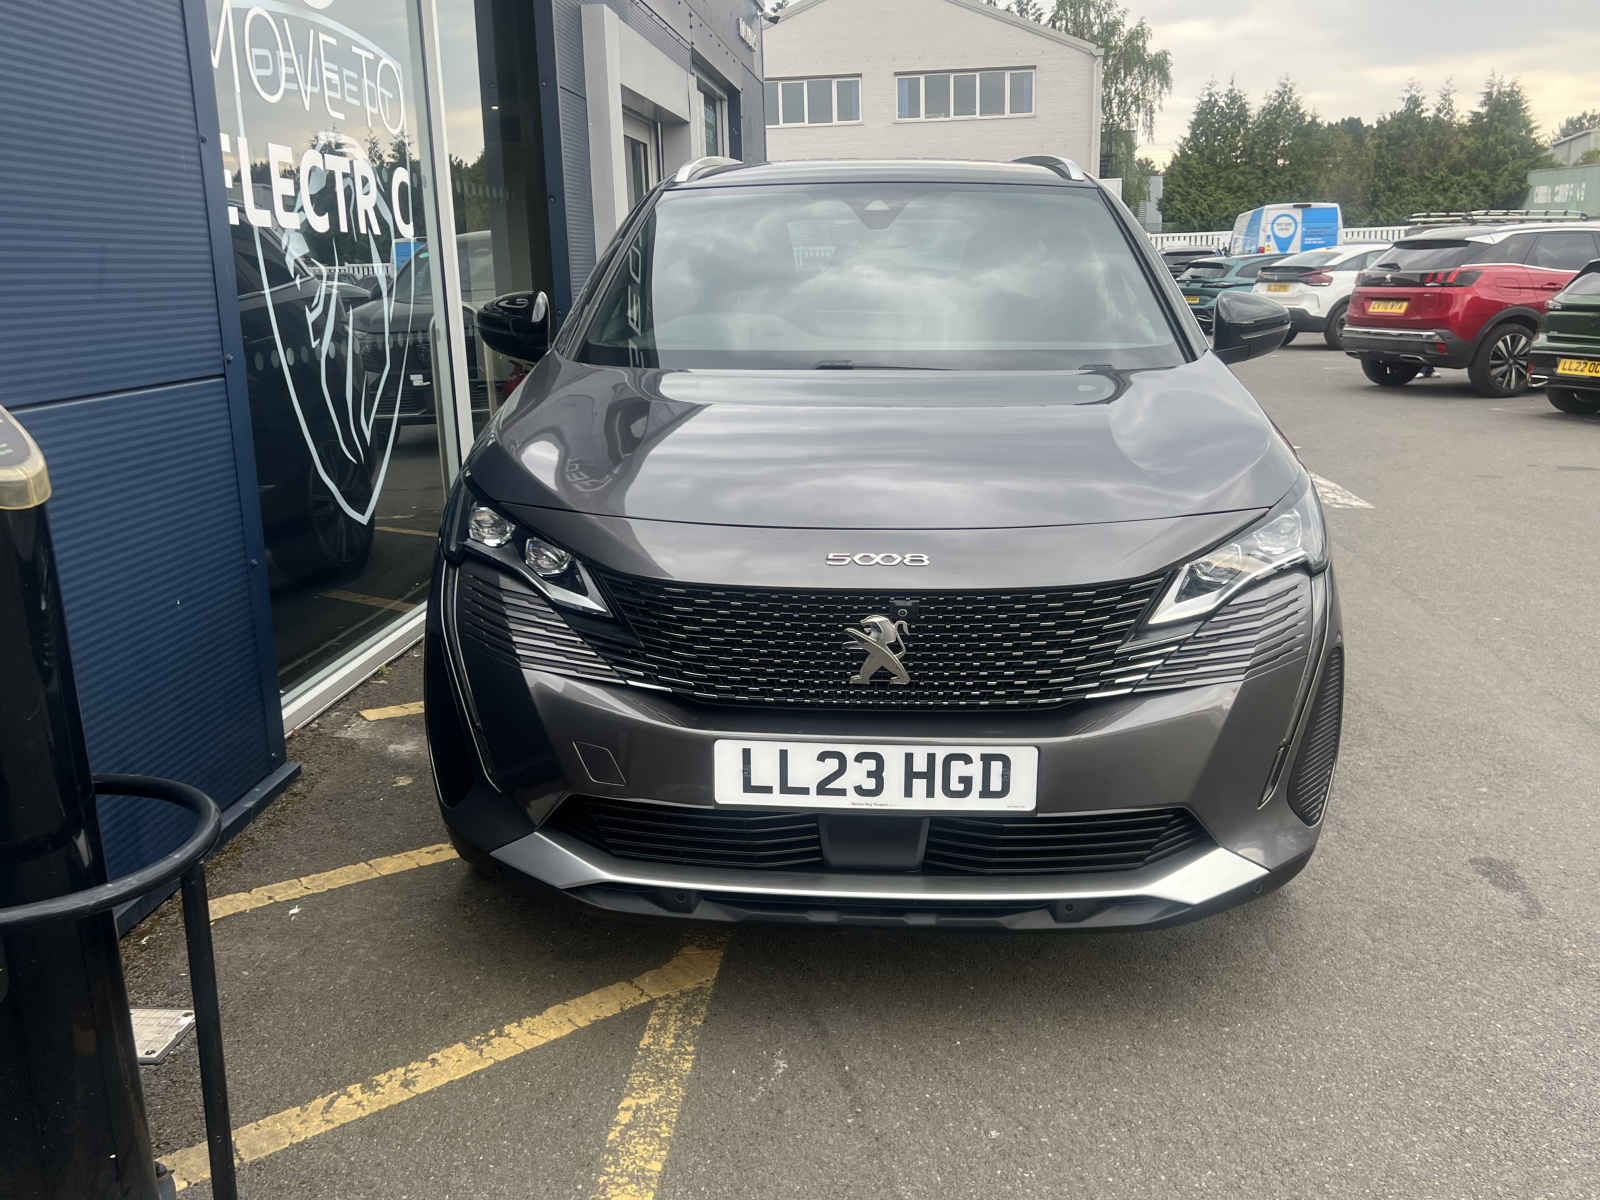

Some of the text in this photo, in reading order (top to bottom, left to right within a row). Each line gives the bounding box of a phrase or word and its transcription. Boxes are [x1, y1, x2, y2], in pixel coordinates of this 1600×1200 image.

[250, 47, 394, 121] PEUGEOT
[351, 46, 404, 135] TO
[1562, 360, 1588, 373] LL22
[825, 553, 931, 567] 5008
[742, 748, 1011, 799] LL23 HGD
